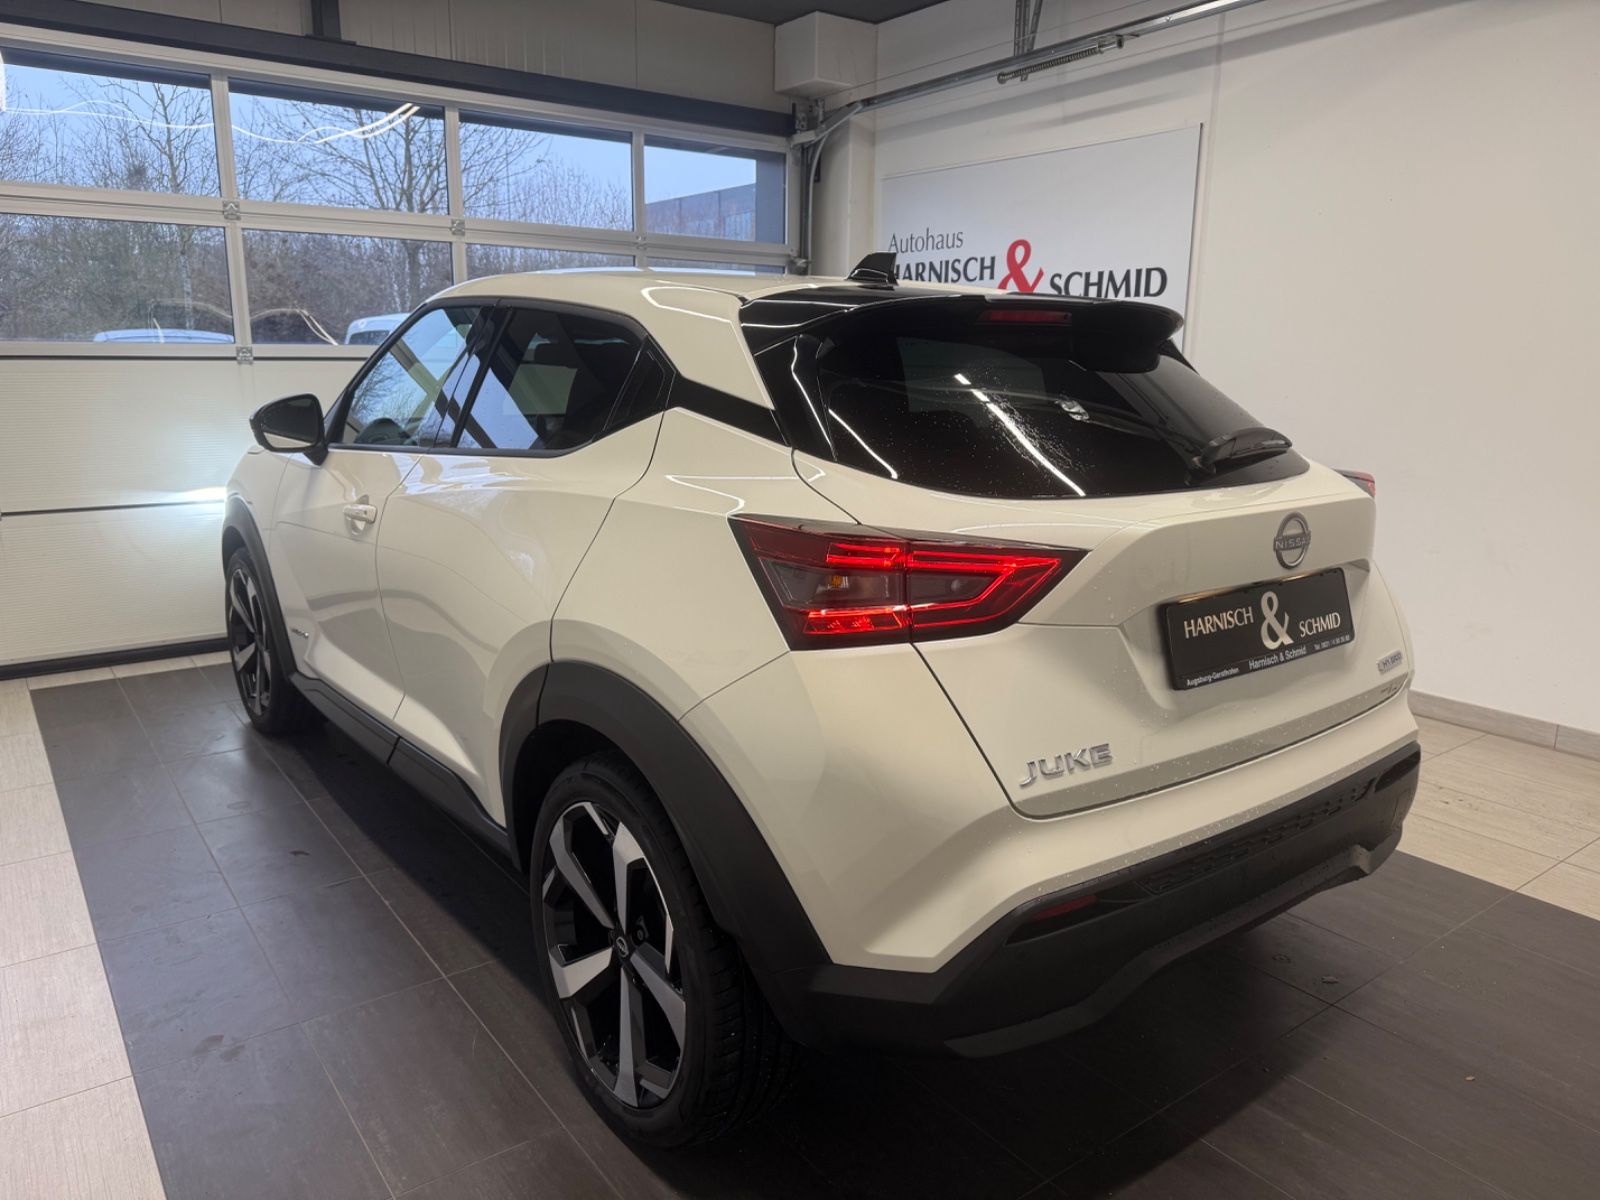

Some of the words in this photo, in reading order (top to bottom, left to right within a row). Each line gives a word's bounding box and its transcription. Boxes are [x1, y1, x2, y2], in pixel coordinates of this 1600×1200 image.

[888, 227, 964, 254] Autohaus
[997, 239, 1045, 293] &
[1050, 267, 1168, 298] SCHMID
[1184, 606, 1254, 639] HARNISCH
[1260, 590, 1294, 650] &
[1300, 611, 1341, 638] SCHMID
[1249, 654, 1279, 669] Harnisch
[1285, 644, 1306, 660] Schmid
[1019, 742, 1113, 788] JUKE
